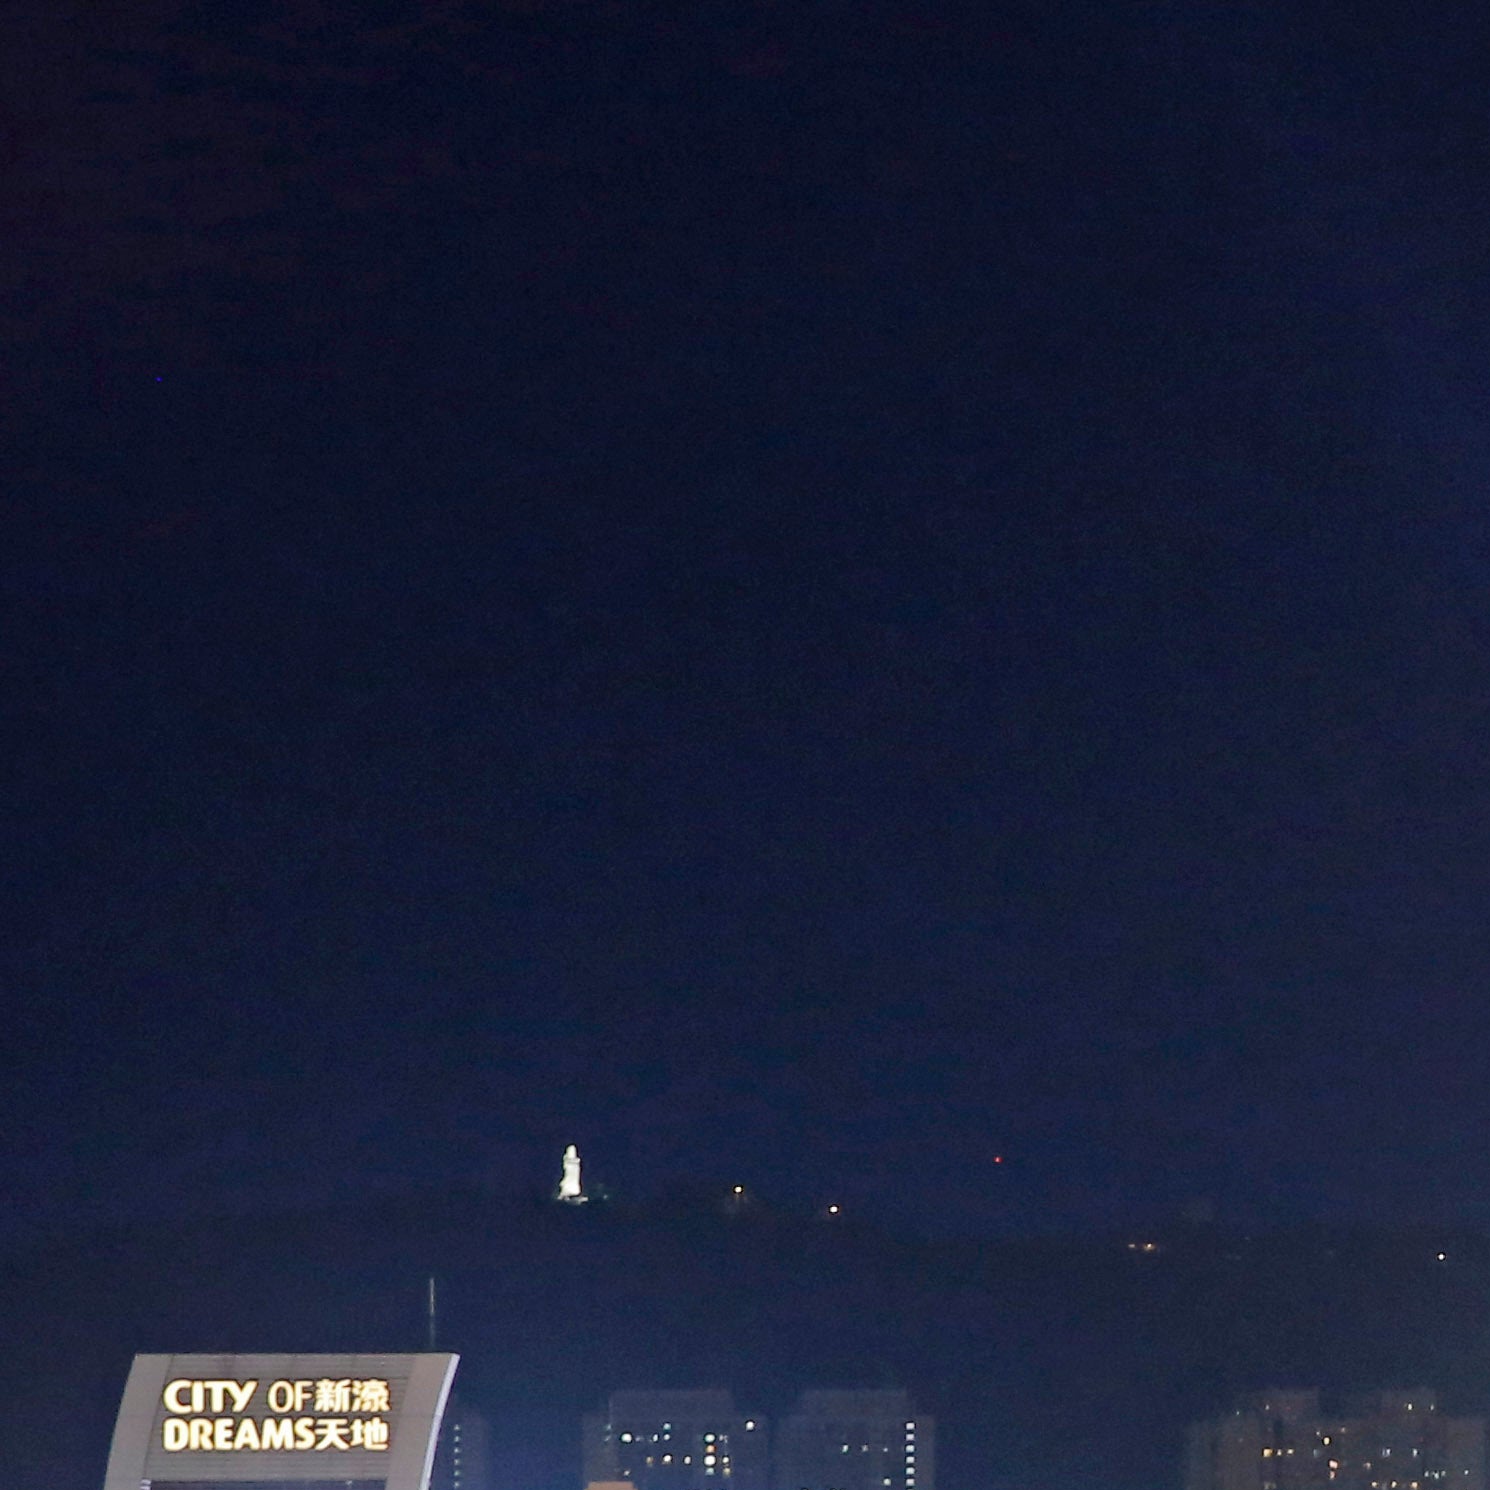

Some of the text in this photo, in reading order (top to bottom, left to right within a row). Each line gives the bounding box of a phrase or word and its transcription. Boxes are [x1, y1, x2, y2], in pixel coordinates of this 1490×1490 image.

[164, 1379, 313, 1414] CITY OF
[314, 1379, 391, 1413] 新濠
[164, 1417, 316, 1451] DREAMS
[314, 1417, 389, 1450] 天地
